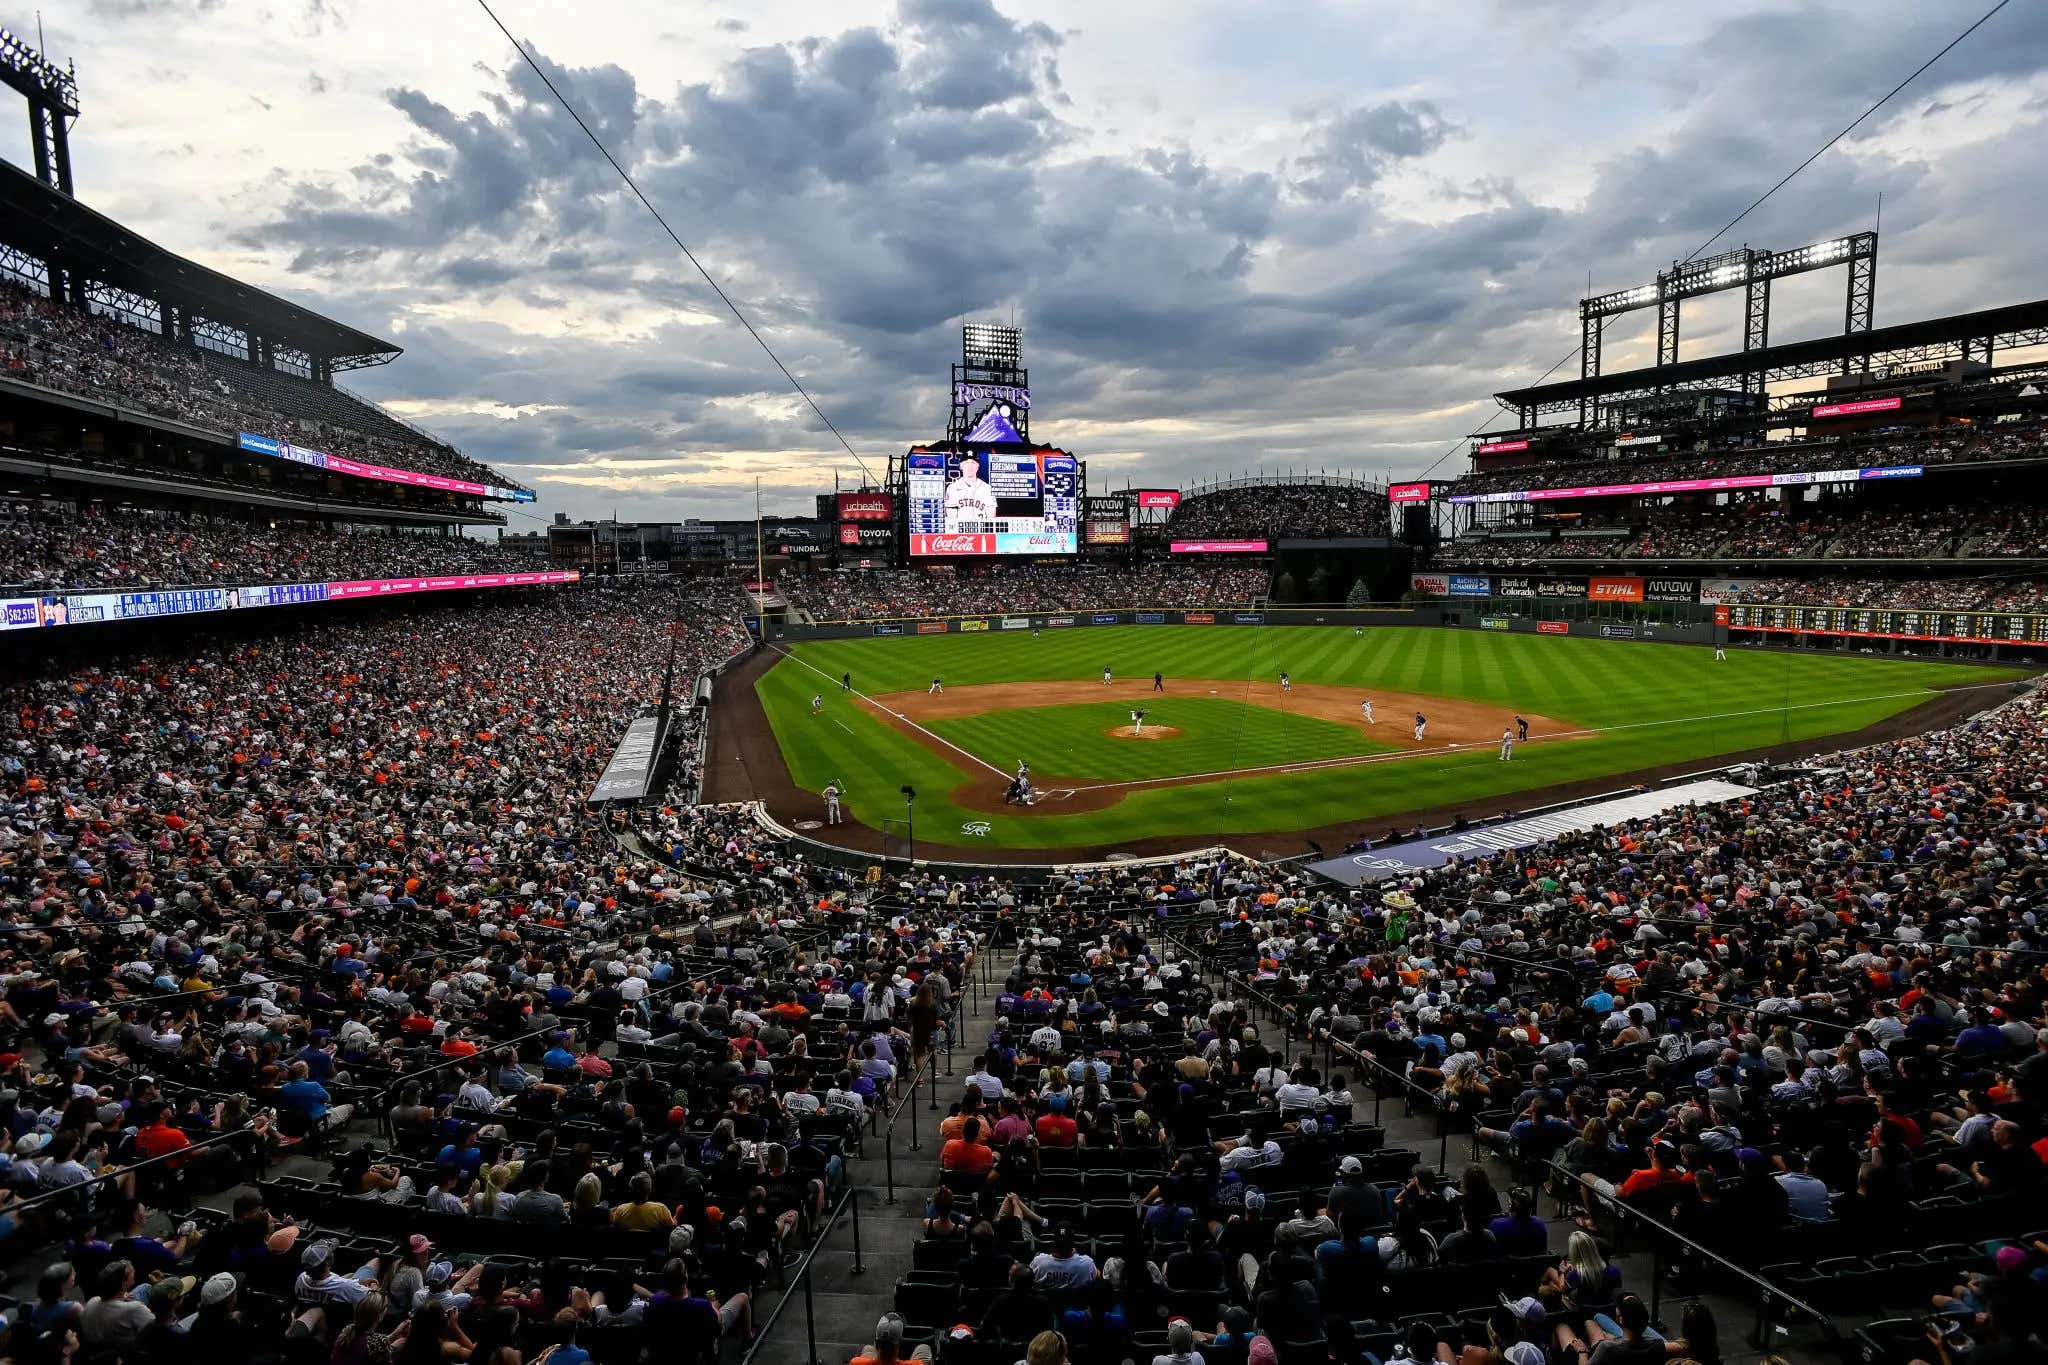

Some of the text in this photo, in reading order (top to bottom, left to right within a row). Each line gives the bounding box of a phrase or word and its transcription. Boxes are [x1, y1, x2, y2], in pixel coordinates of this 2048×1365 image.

[1890, 366, 1911, 376] JACK
[957, 384, 1032, 408] ROCKIES
[846, 500, 884, 510] uchealth
[1501, 578, 1528, 587] Bank of
[1538, 583, 1554, 592] BLUE
[1501, 587, 1534, 596] Colorado
[1595, 584, 1636, 594] STIHL
[70, 597, 83, 607] ALEX
[9, 608, 35, 622] $62,515
[70, 607, 102, 621] BREGMAN
[1482, 619, 1507, 628] bet365
